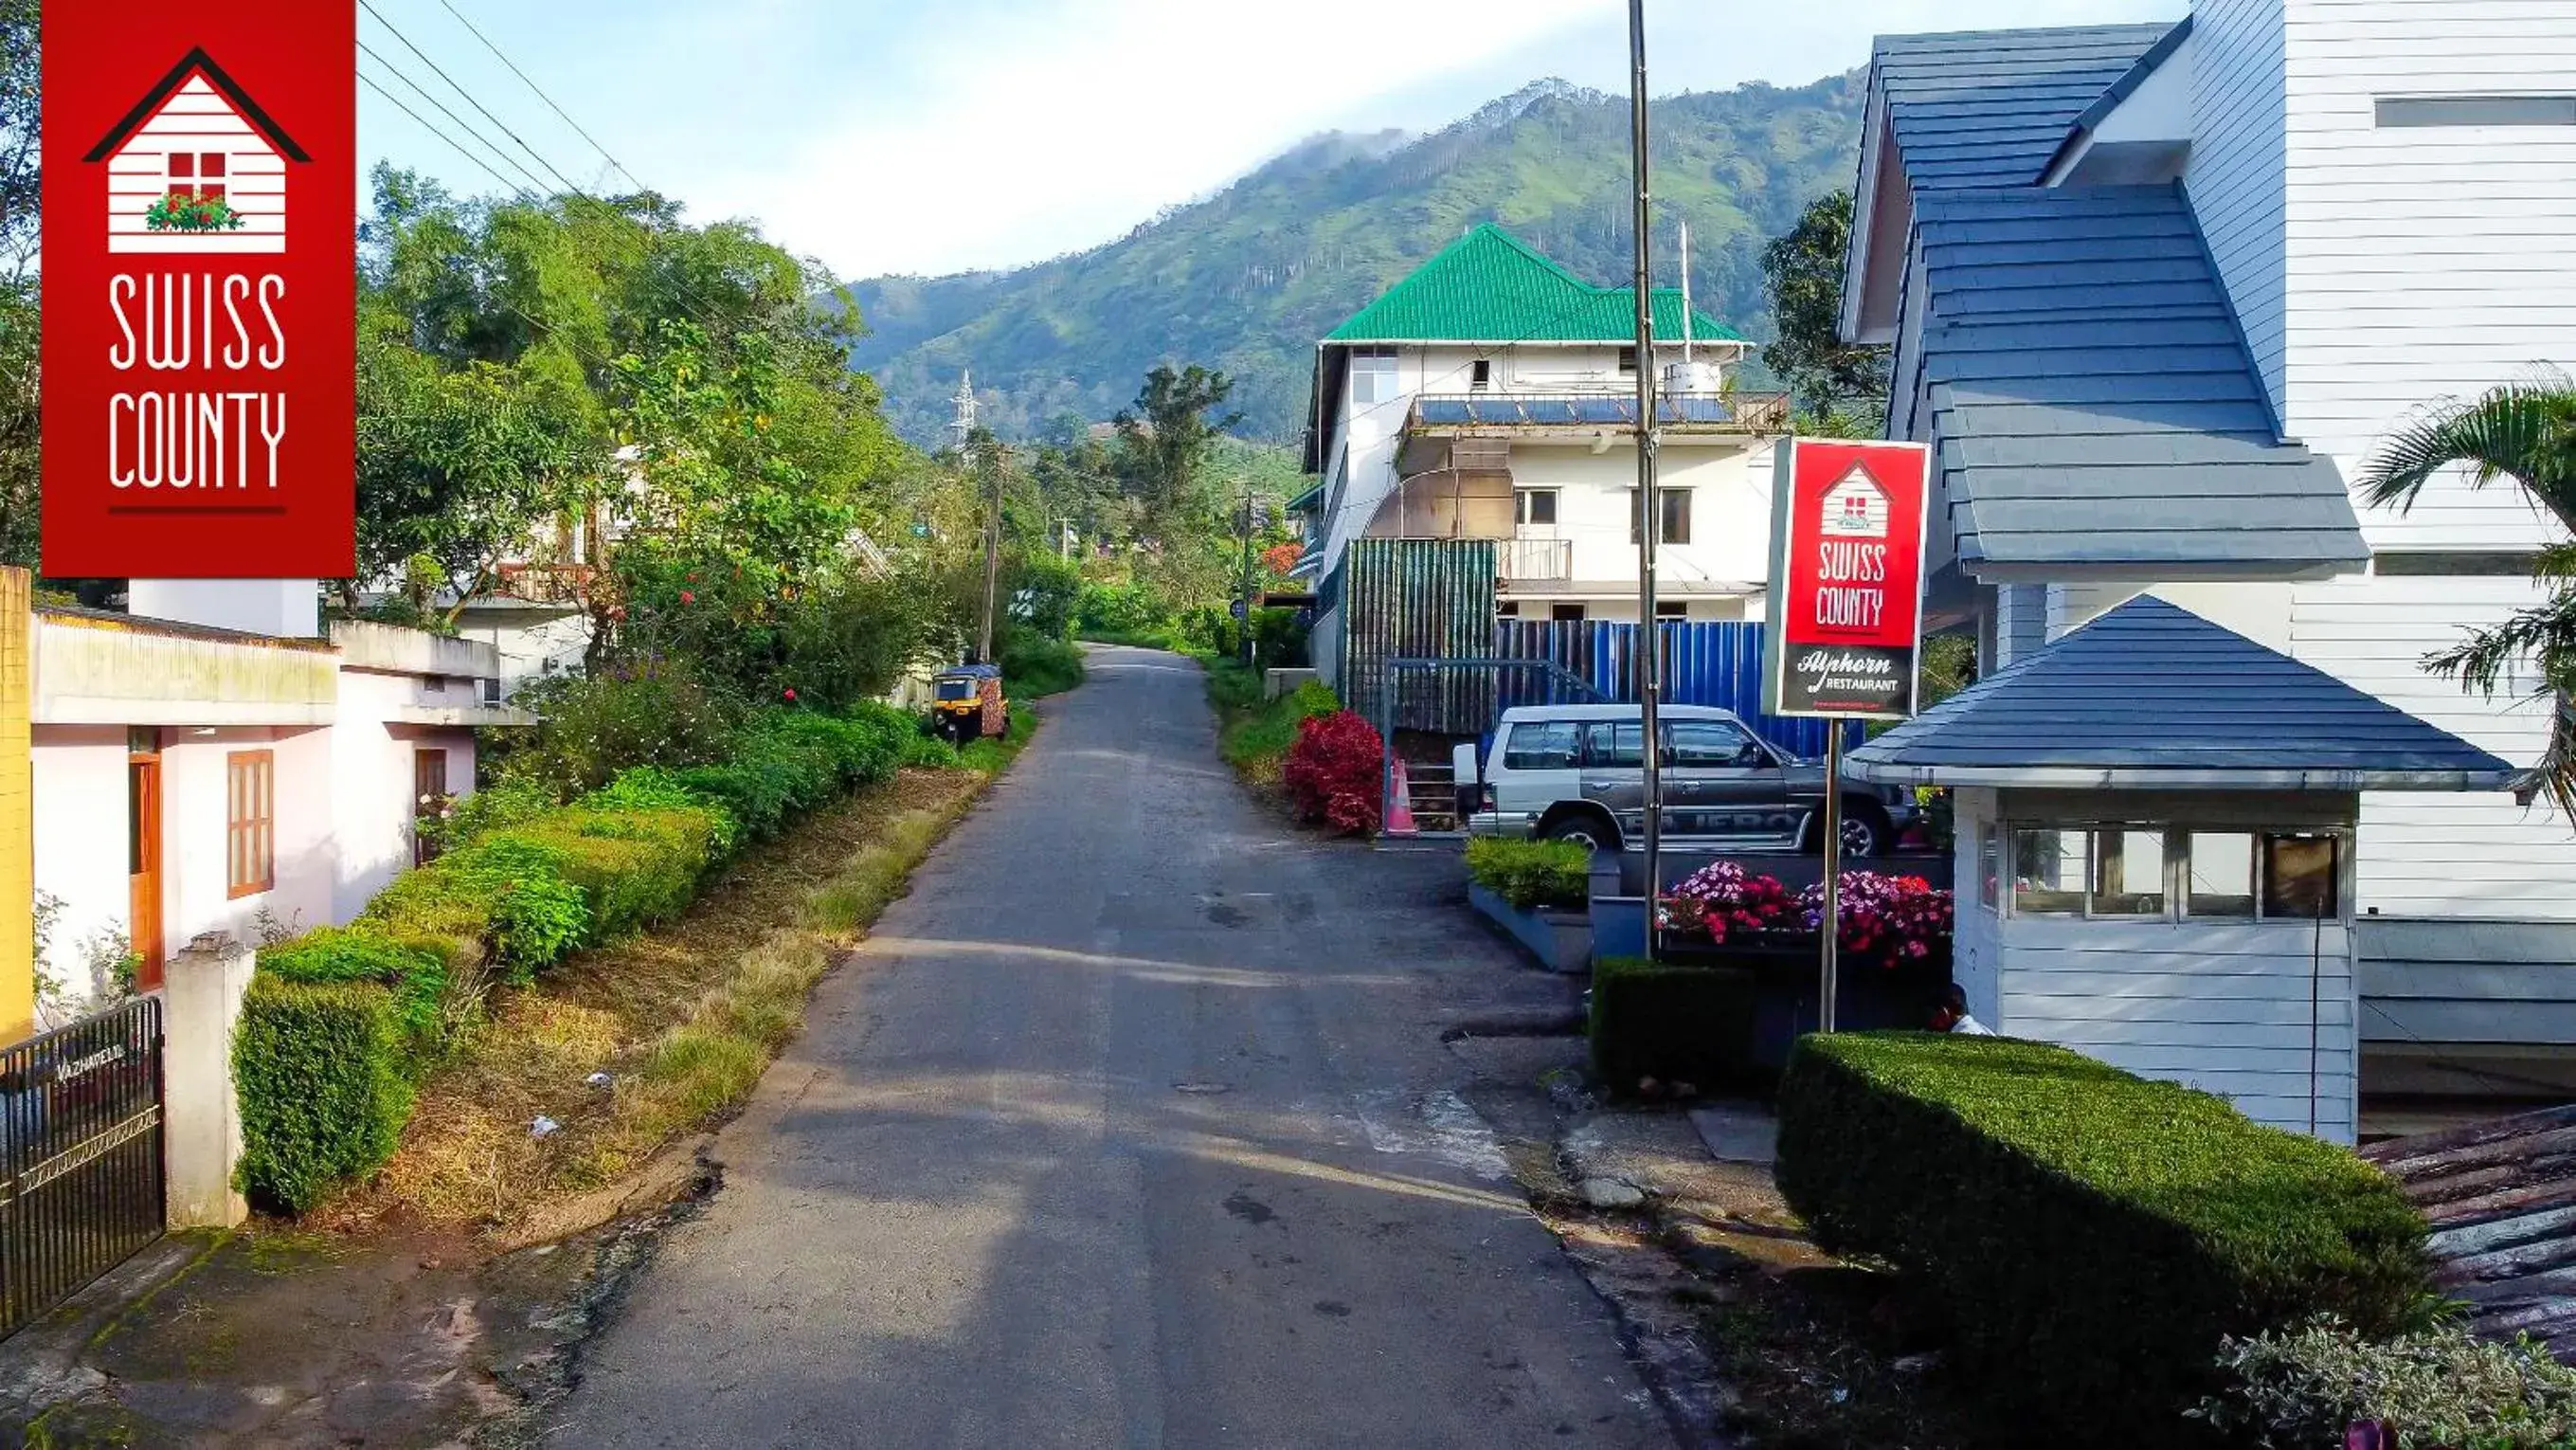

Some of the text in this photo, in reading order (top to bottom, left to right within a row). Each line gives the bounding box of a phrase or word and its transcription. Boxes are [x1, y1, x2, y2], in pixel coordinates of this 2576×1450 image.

[1818, 541, 1886, 582] SWISS
[1816, 587, 1883, 626] COUNTY
[1797, 651, 1891, 693] Alphorn
[1826, 678, 1899, 691] RESTAURANT
